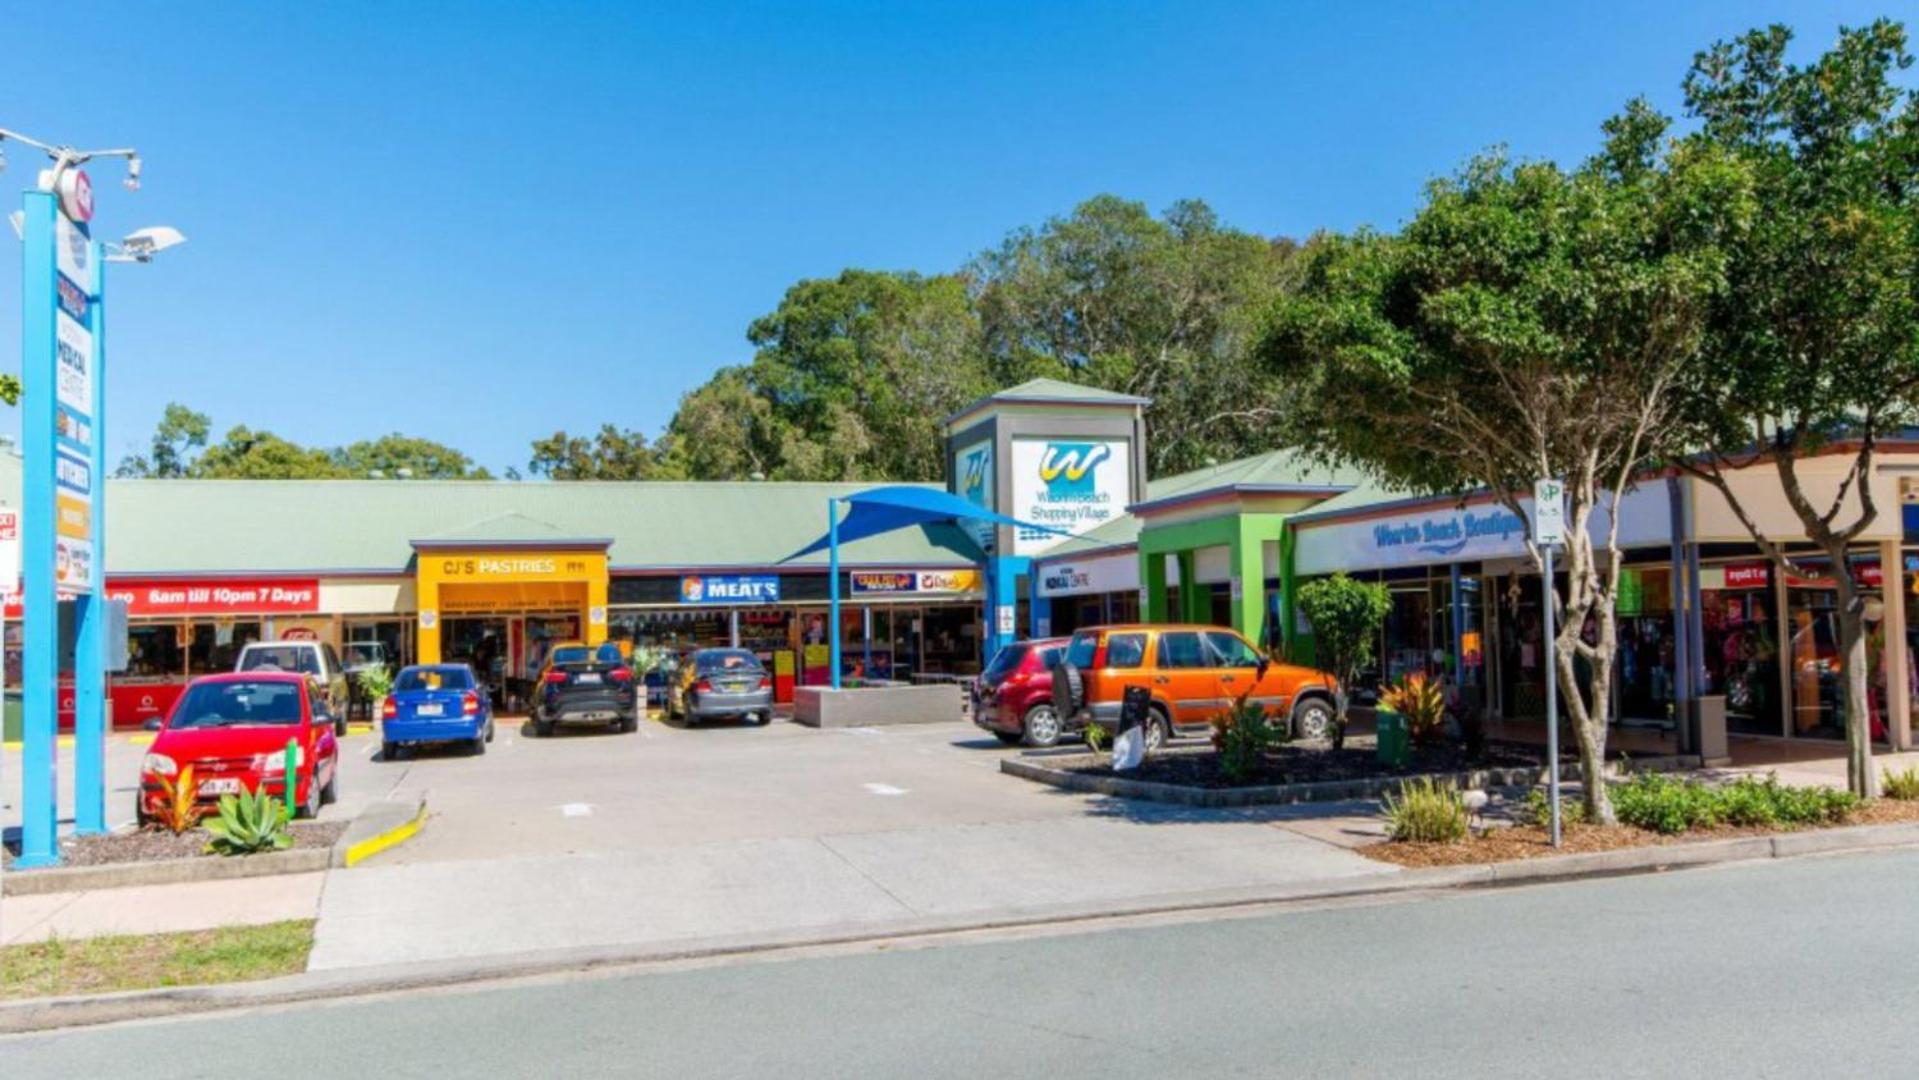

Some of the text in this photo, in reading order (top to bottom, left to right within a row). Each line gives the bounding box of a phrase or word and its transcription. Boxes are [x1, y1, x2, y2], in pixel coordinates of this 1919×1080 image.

[1031, 505, 1110, 521] Shopping Village
[479, 559, 556, 573] PASTRIES
[150, 589, 185, 604] 6am
[188, 588, 210, 603] till
[213, 588, 256, 605] 10pm
[259, 588, 270, 603] 7
[271, 588, 312, 605] Days
[708, 583, 777, 597] MEATS
